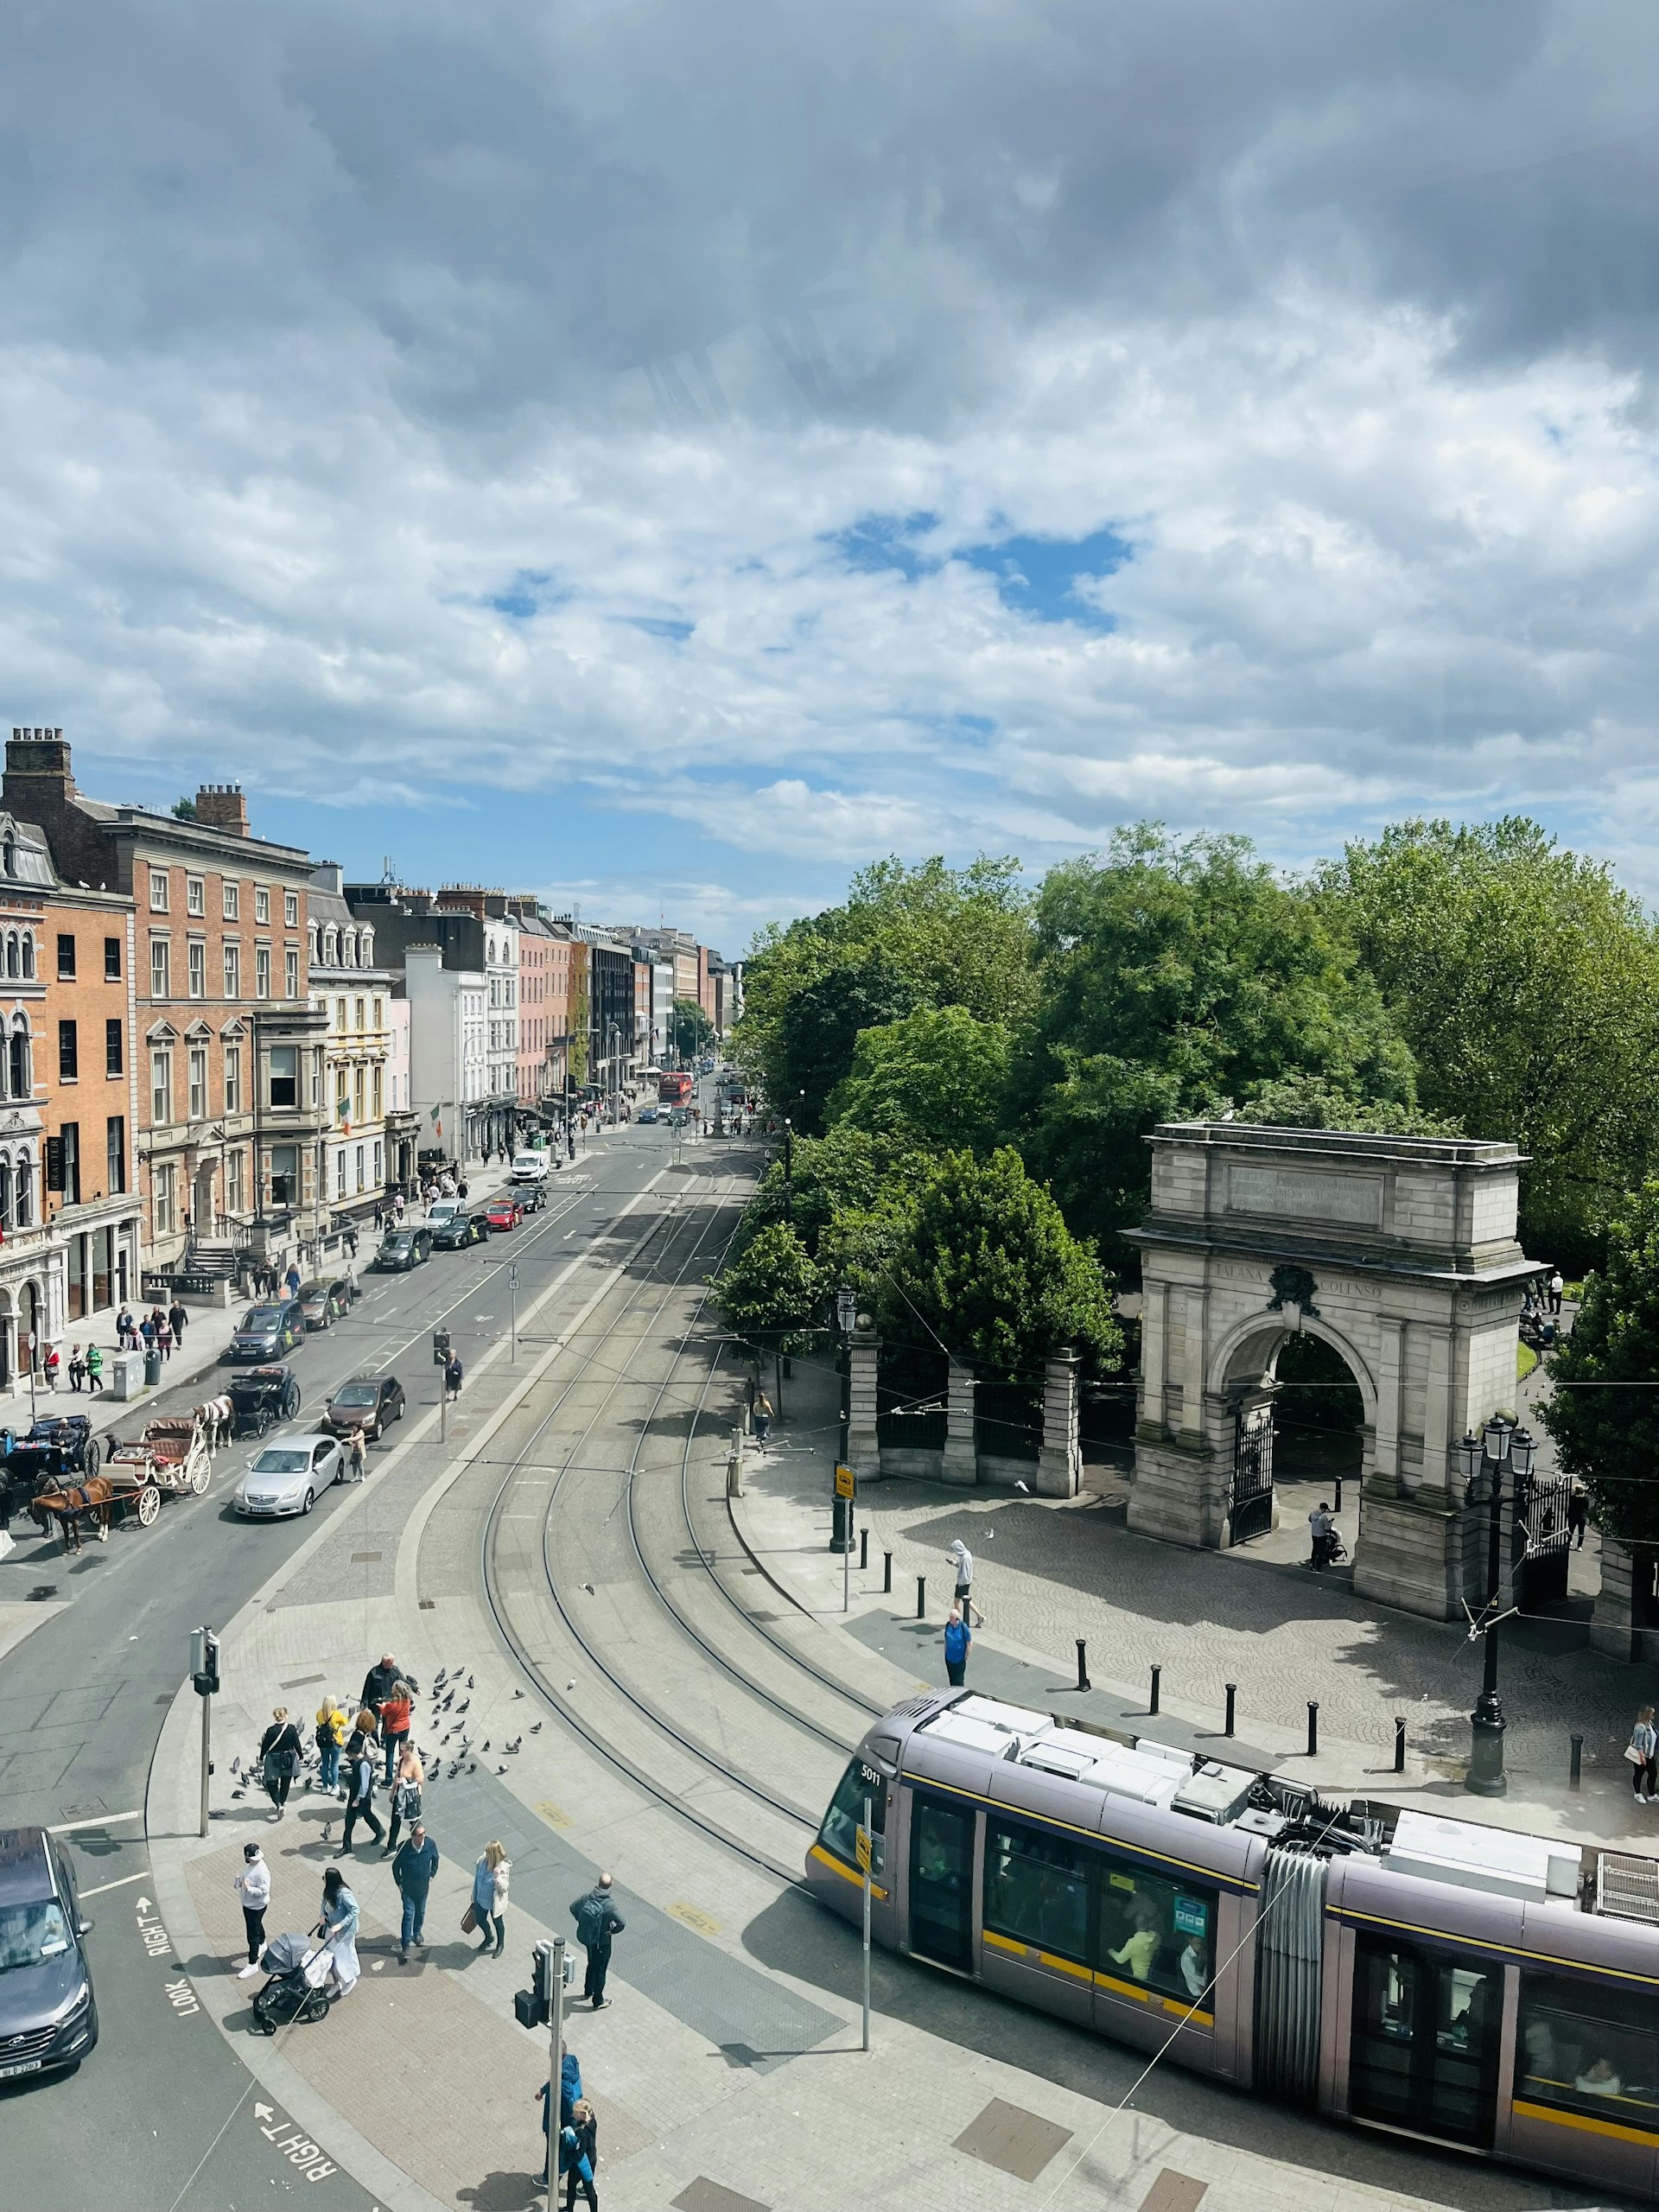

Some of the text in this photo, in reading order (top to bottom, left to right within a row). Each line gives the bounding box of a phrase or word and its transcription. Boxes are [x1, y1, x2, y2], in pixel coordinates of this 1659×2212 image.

[50, 1140, 60, 1189] GRAFTER
[1320, 1280, 1382, 1300] COLENSO
[861, 1764, 880, 1787] 5011
[136, 1916, 200, 2017] LOOK RIGHT
[259, 2122, 338, 2183] RIGHT
